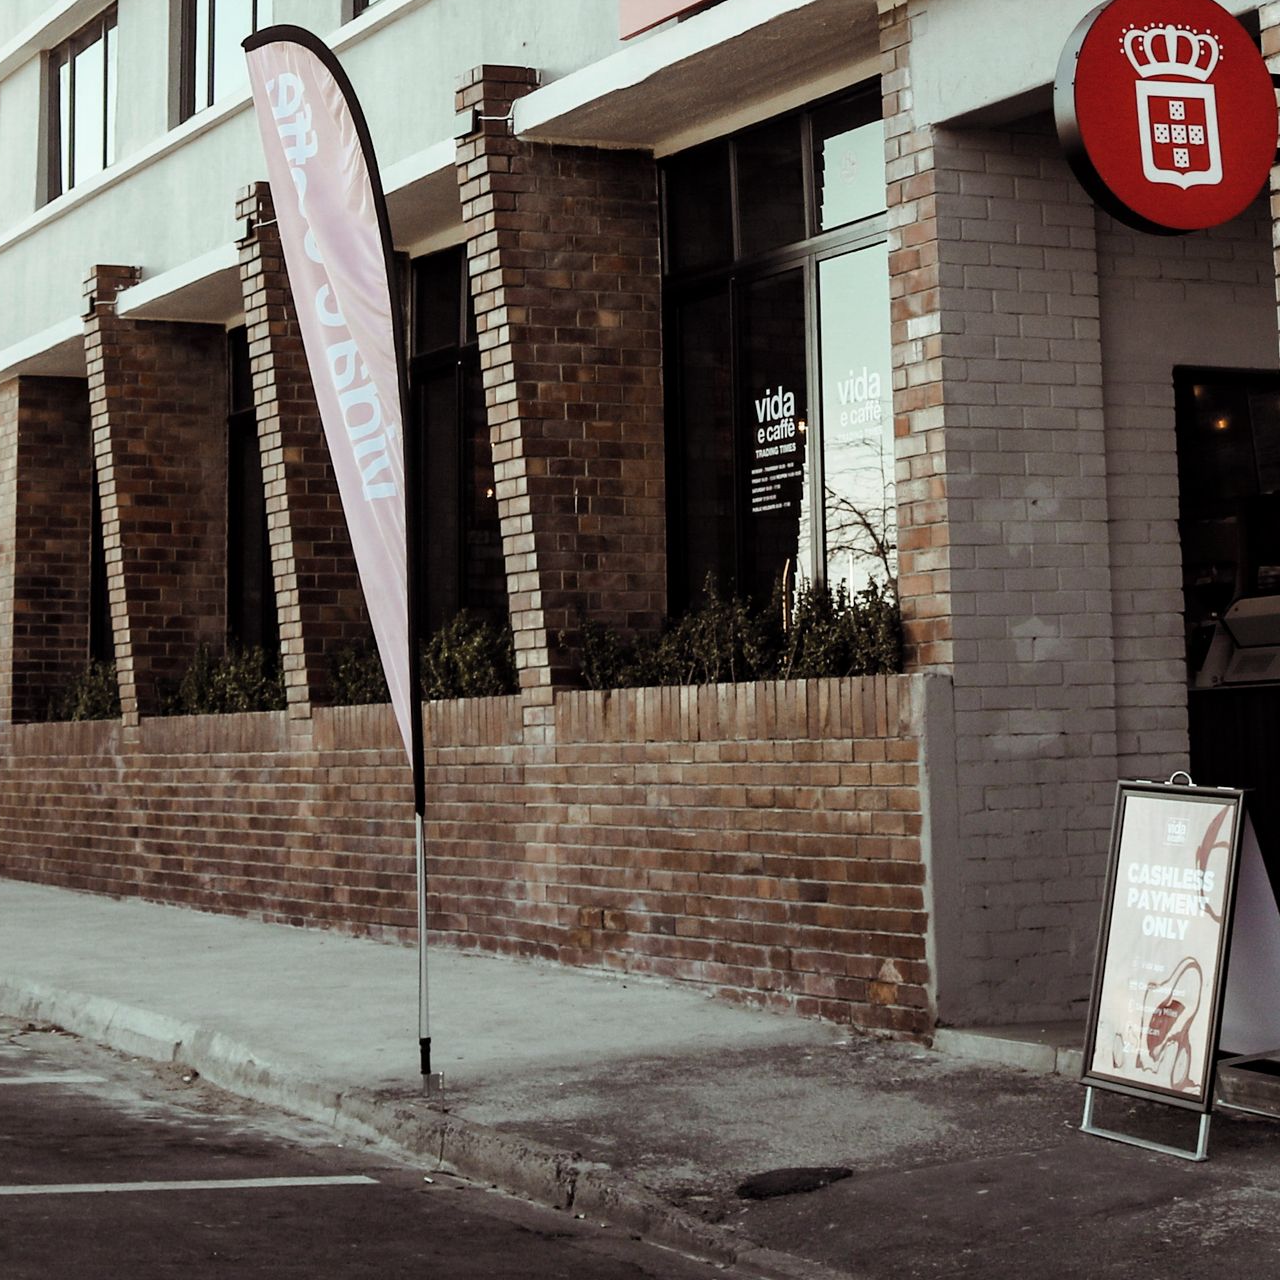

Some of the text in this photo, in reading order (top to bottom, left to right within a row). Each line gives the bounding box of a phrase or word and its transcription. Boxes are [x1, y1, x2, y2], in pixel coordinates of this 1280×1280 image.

[837, 366, 881, 405] vida
[755, 385, 795, 423] vida
[840, 410, 849, 427] e
[757, 427, 766, 444] e
[755, 442, 796, 459] TRADING TIMES
[1127, 862, 1216, 892] CASHLESS
[1126, 887, 1210, 917] PAYMENT
[1142, 914, 1189, 940] ONLY
